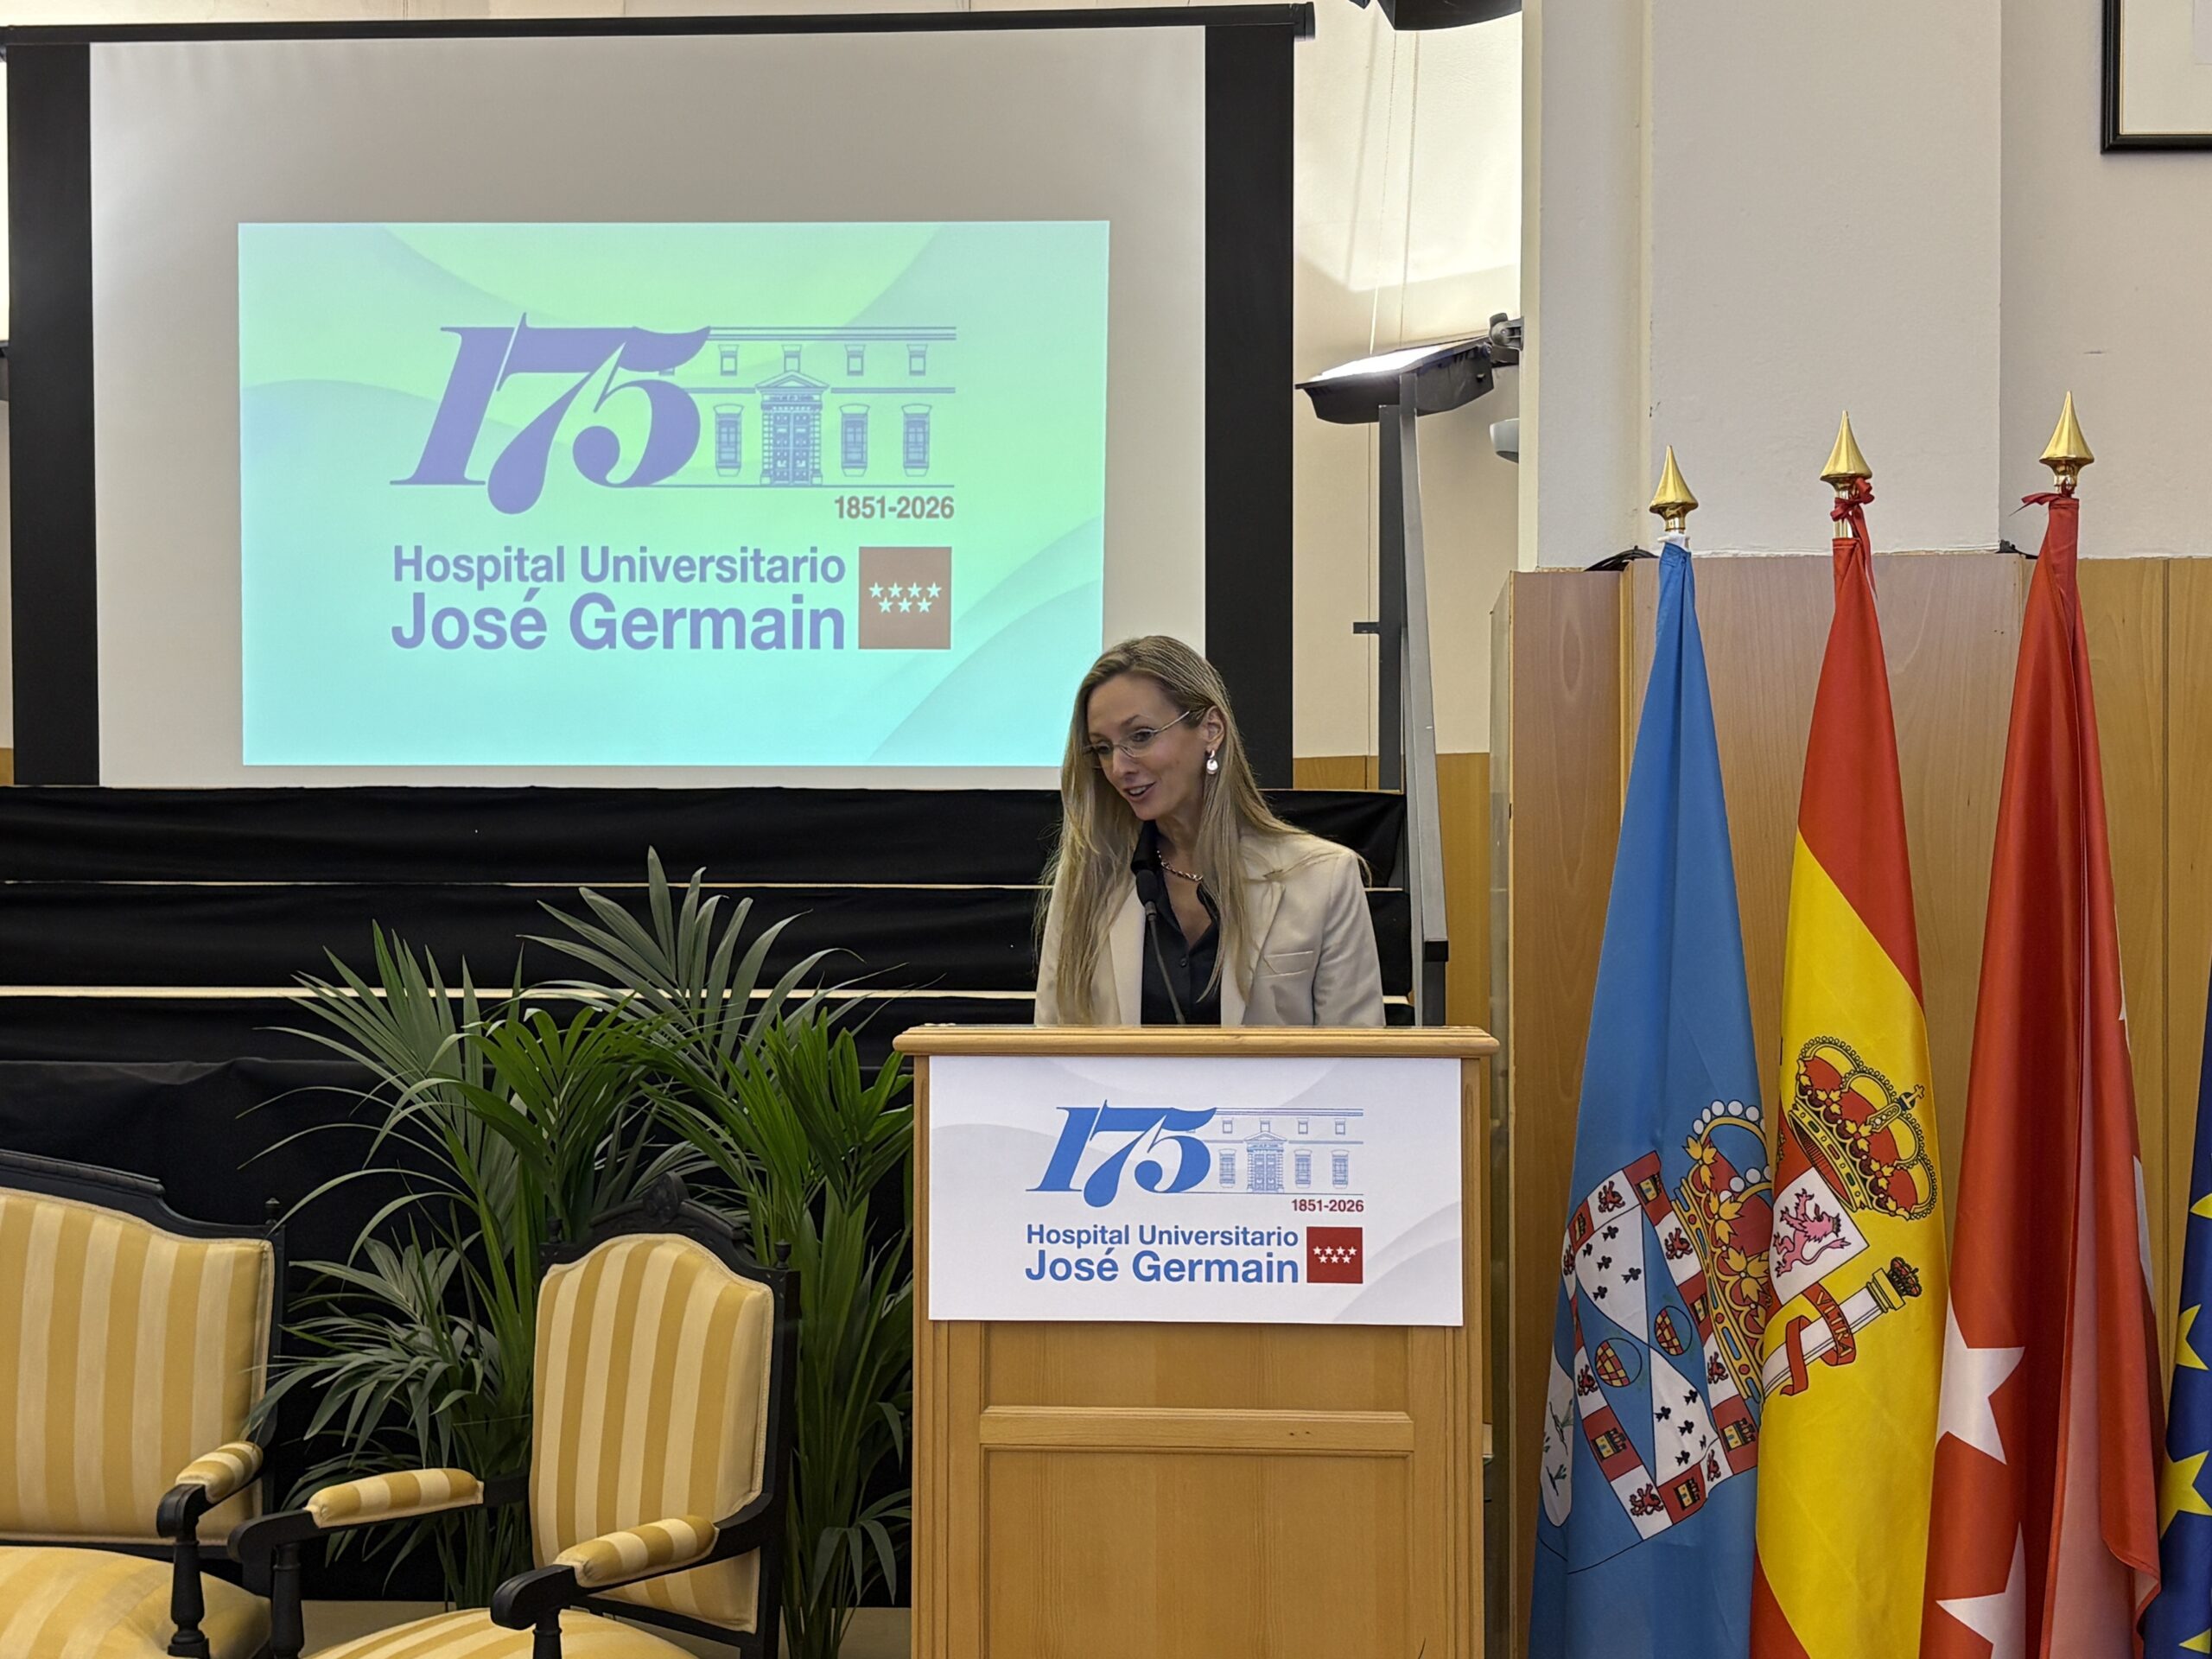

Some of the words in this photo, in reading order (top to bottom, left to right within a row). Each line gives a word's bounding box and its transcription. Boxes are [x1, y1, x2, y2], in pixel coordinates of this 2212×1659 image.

[391, 312, 711, 515] 175
[834, 495, 955, 519] 1851-2026
[393, 545, 565, 590] Hospital
[580, 545, 846, 585] Universitario
[391, 588, 548, 651] José
[569, 592, 845, 651] Germain
[1026, 1099, 1217, 1208] 175
[1292, 1198, 1364, 1212] 1851-2026
[1027, 1224, 1129, 1249] Hospital
[1139, 1224, 1299, 1246] Universitario
[1026, 1247, 1119, 1281] José
[1132, 1249, 1299, 1284] Germain
